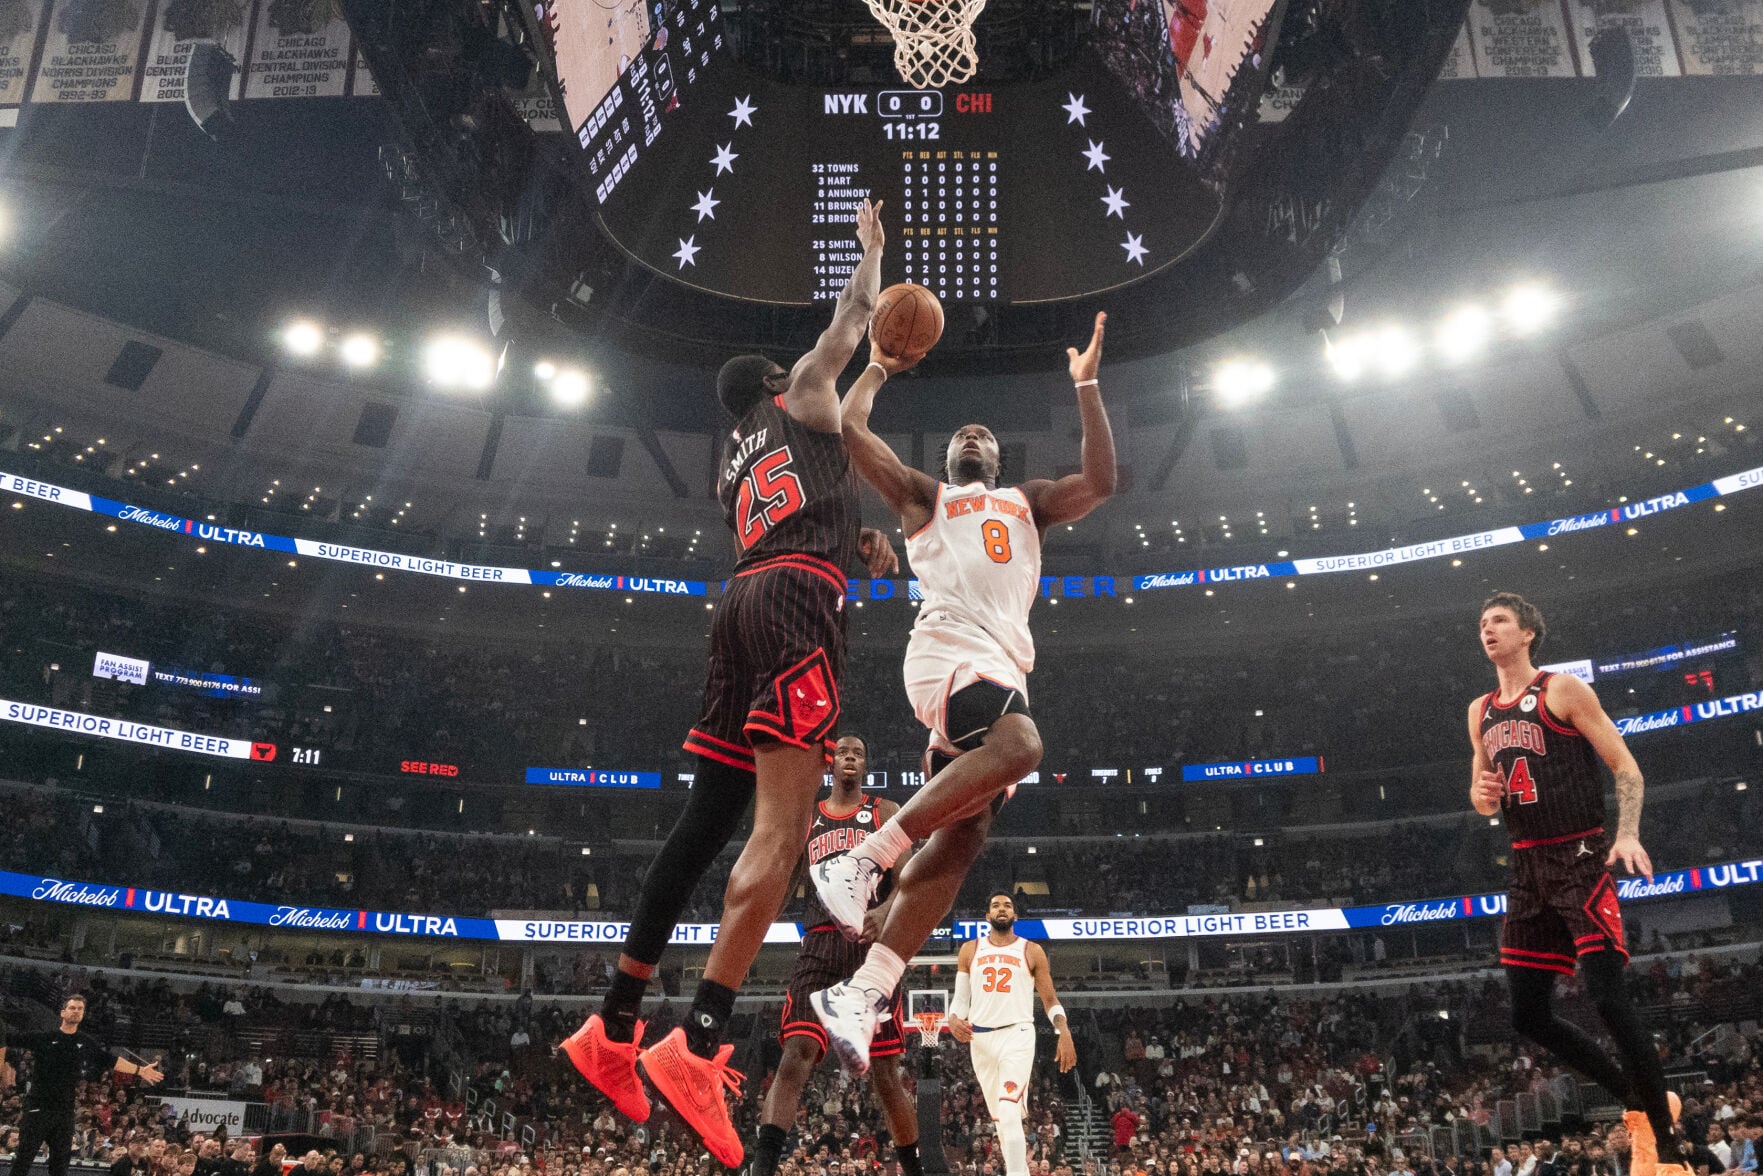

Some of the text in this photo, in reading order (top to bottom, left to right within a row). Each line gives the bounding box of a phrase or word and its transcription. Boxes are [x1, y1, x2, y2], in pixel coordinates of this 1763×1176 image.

[68, 44, 116, 55] CHICAGO
[278, 38, 326, 48] CHICAGO
[51, 56, 126, 66] BLACKHAWKS
[261, 49, 338, 60] BLACKHAWKS
[41, 66, 133, 77] NORRIS DIVISION
[250, 60, 346, 72] CENTRAL DIVISION
[52, 78, 117, 88] CHAMPIONS
[264, 73, 329, 84] CHAMPIONS
[58, 90, 107, 100] 1992-93
[273, 86, 316, 96] 2012-13
[824, 93, 992, 114] NYK 0 0 CHI
[883, 122, 940, 140] 11:12
[812, 164, 824, 172] 32
[828, 164, 859, 172] TOWNS
[905, 164, 911, 172] 0
[922, 164, 927, 172] 1
[939, 163, 945, 171] 0
[956, 163, 962, 171] 0
[990, 163, 996, 171] 0
[818, 177, 824, 185] 3
[828, 176, 850, 185] HART
[905, 176, 911, 184] 0
[922, 176, 928, 184] 0
[939, 176, 945, 184] 0
[956, 176, 962, 184] 0
[990, 176, 996, 184] 0
[818, 188, 996, 198] 8 ANUNOBY 0 1 0 0 0 0
[814, 202, 824, 210] 11
[905, 201, 911, 209] 0
[922, 201, 928, 209] 0
[939, 201, 945, 209] 0
[956, 201, 962, 209] 0
[990, 201, 996, 209] 0
[812, 215, 825, 223] 25
[905, 214, 911, 222] 0
[922, 214, 928, 222] 0
[939, 214, 945, 222] 0
[956, 213, 962, 222] 0
[973, 213, 979, 221] 0
[990, 213, 996, 221] 0
[812, 240, 856, 249] 25 SMITH
[819, 253, 862, 261] 8 WILSON
[814, 266, 826, 274] 14
[726, 428, 767, 484] SMITH
[736, 445, 806, 550] 25
[944, 494, 1031, 526] NEW YORK
[13, 479, 61, 500] BEER
[118, 505, 180, 531] Michelob
[198, 524, 265, 548] ULTRA
[318, 544, 402, 567] SUPERIOR
[408, 558, 455, 575] LIGHT
[461, 567, 503, 580] BEER
[556, 573, 613, 589] Michelob
[630, 578, 688, 594] ULTRA
[982, 518, 1012, 564] 8
[1140, 492, 1690, 589] Michelob ULTRA SUPERIOR LIGHT BEER Michelob ULTRA
[1600, 639, 1736, 672] TEXT FOR ASSISTANCE
[101, 659, 143, 672] FAN ASSIST
[99, 666, 143, 679] PROGRAM
[155, 672, 175, 682] TEXT
[222, 682, 239, 691] FOR
[240, 685, 261, 694] ASSI
[1617, 711, 1678, 736] Michelob
[8, 704, 320, 765] SUPERIOR LIGHT BEER 7:11
[400, 760, 459, 777] SEE RED
[1205, 762, 1294, 776] ULTRA CLUB
[549, 772, 638, 785] ULTRA CLUB
[809, 828, 871, 866] CHICAG
[1618, 874, 1685, 899] Michelob
[32, 878, 119, 907] Michelob
[144, 891, 230, 918] ULTRA
[269, 906, 351, 929] Michelob
[376, 913, 458, 935] ULTRA
[1072, 902, 1456, 936] SUPERIOR LIGHT BEER Michelob
[977, 954, 1022, 968] NEW YORK
[982, 967, 1012, 993] 32
[181, 1108, 239, 1126] Advocate
